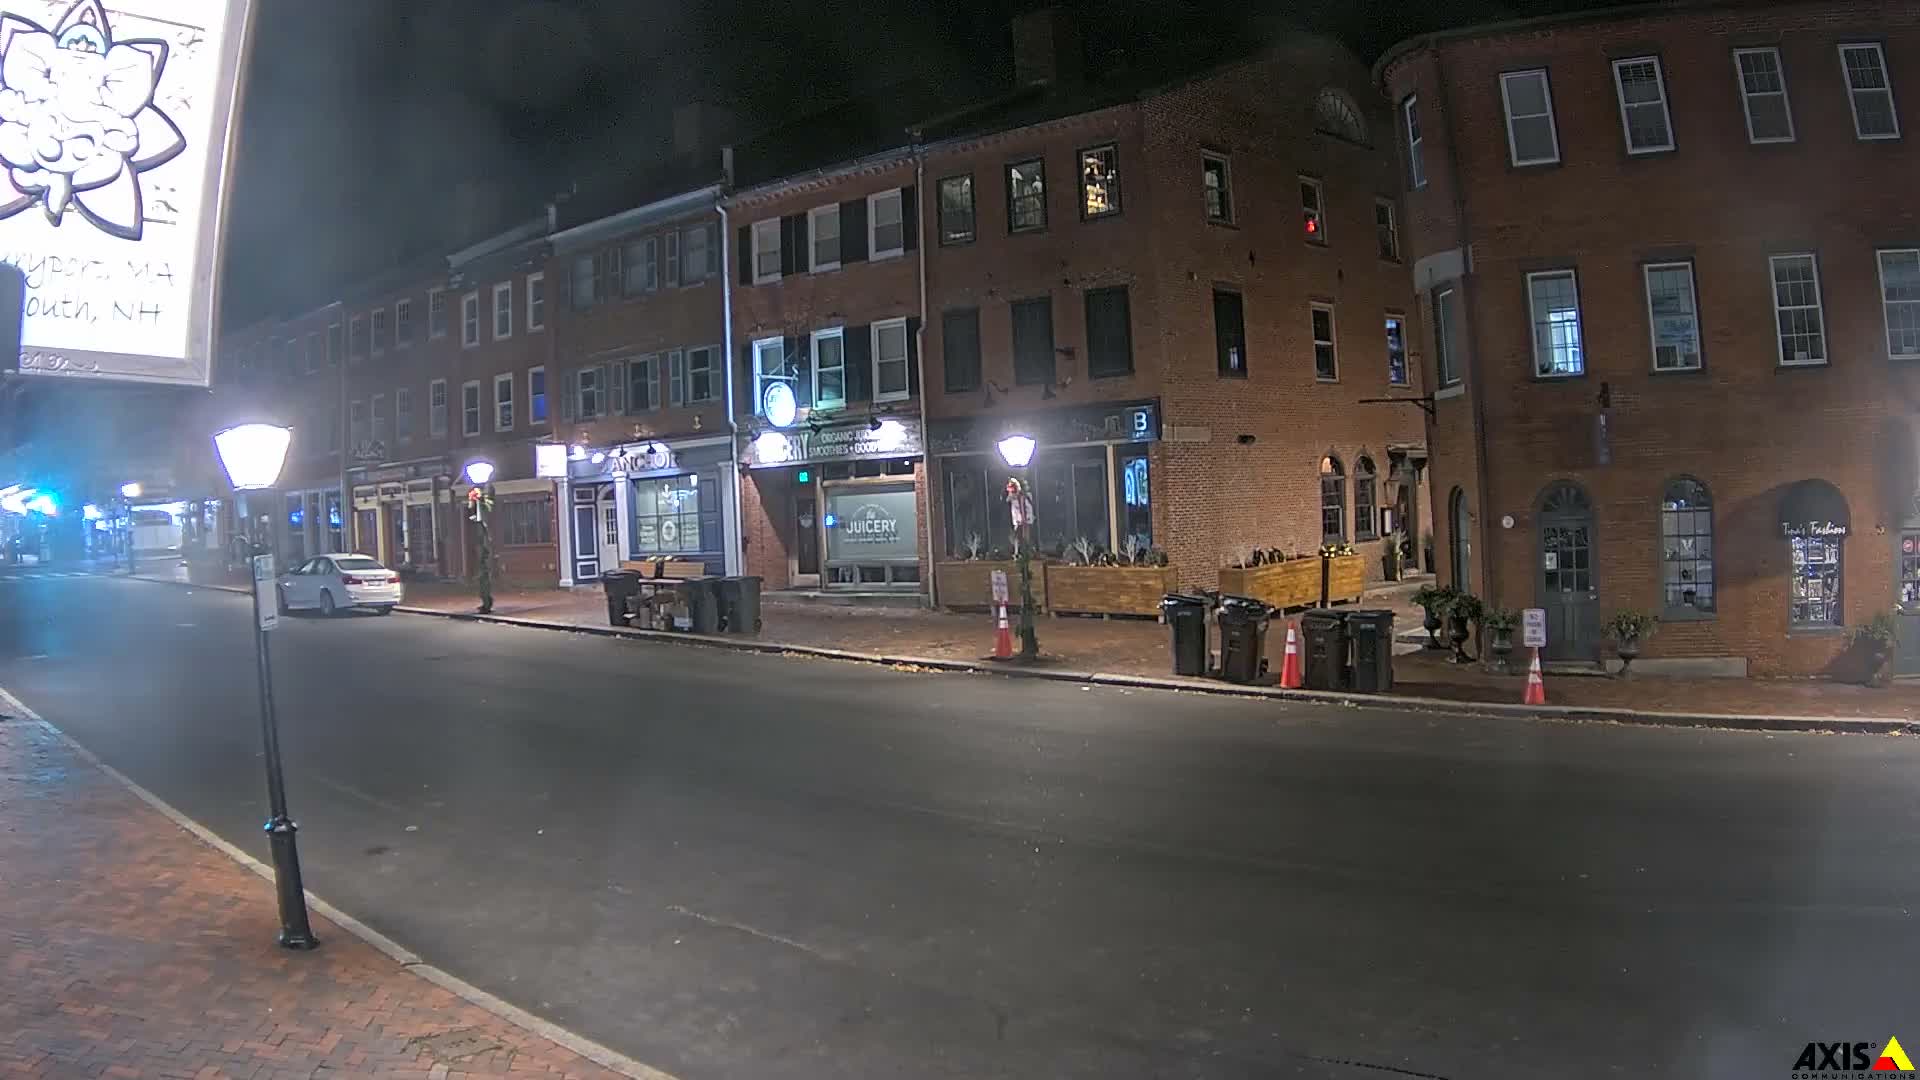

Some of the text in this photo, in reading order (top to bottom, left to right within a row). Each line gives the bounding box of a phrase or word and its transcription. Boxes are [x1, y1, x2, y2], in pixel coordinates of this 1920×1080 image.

[112, 300, 161, 326] NH
[1134, 411, 1147, 431] B
[846, 519, 897, 534] JUICERY
